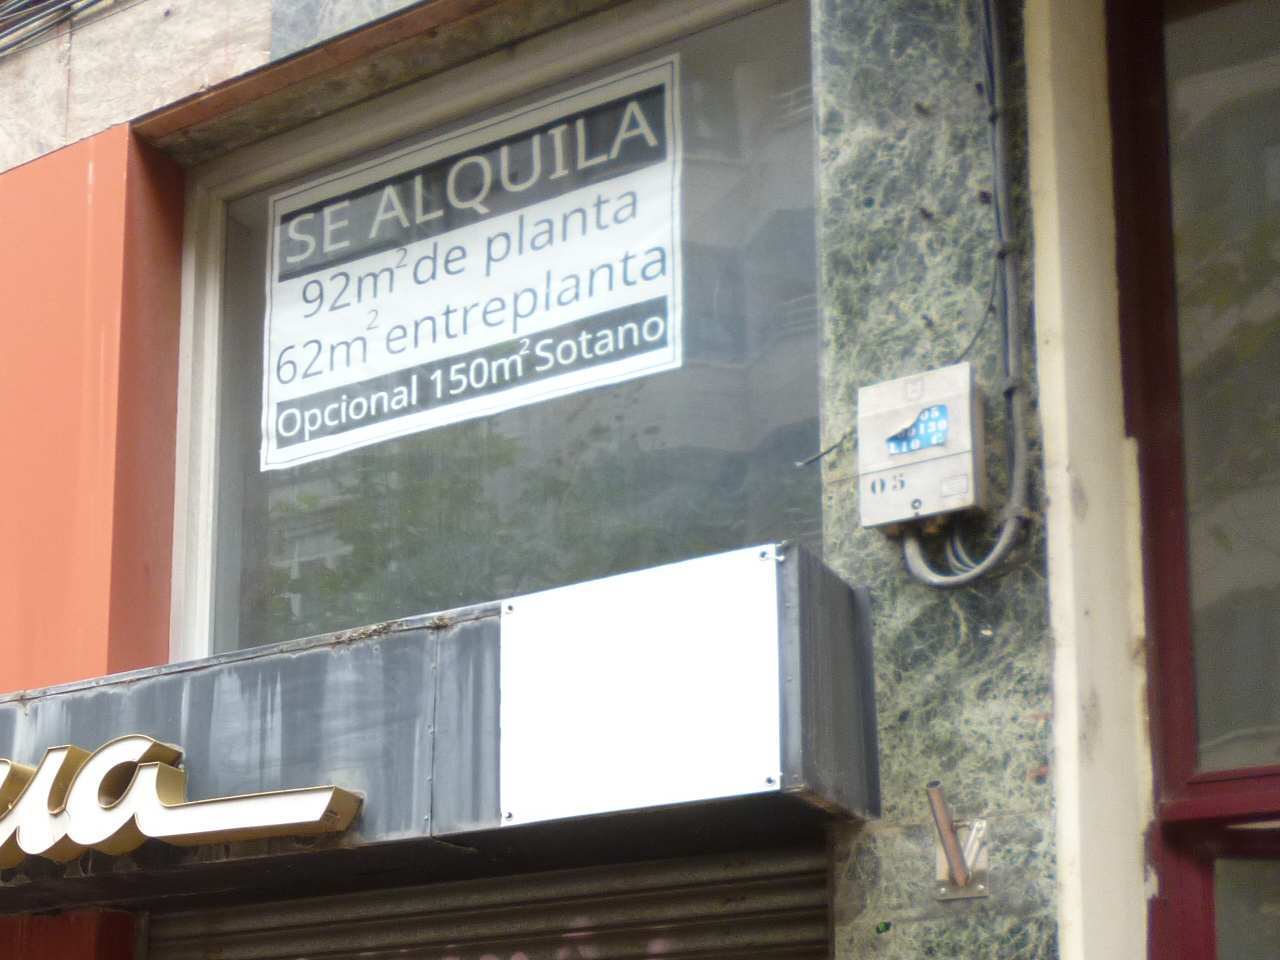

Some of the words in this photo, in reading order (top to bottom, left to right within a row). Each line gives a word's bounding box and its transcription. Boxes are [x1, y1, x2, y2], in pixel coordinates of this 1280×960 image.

[286, 199, 353, 264] SE
[368, 101, 659, 239] ALQUILA
[413, 242, 467, 285] de
[485, 190, 638, 278] planta
[385, 245, 667, 356] entreplanta
[277, 374, 418, 441] Opcional
[534, 314, 666, 372] Sotano
